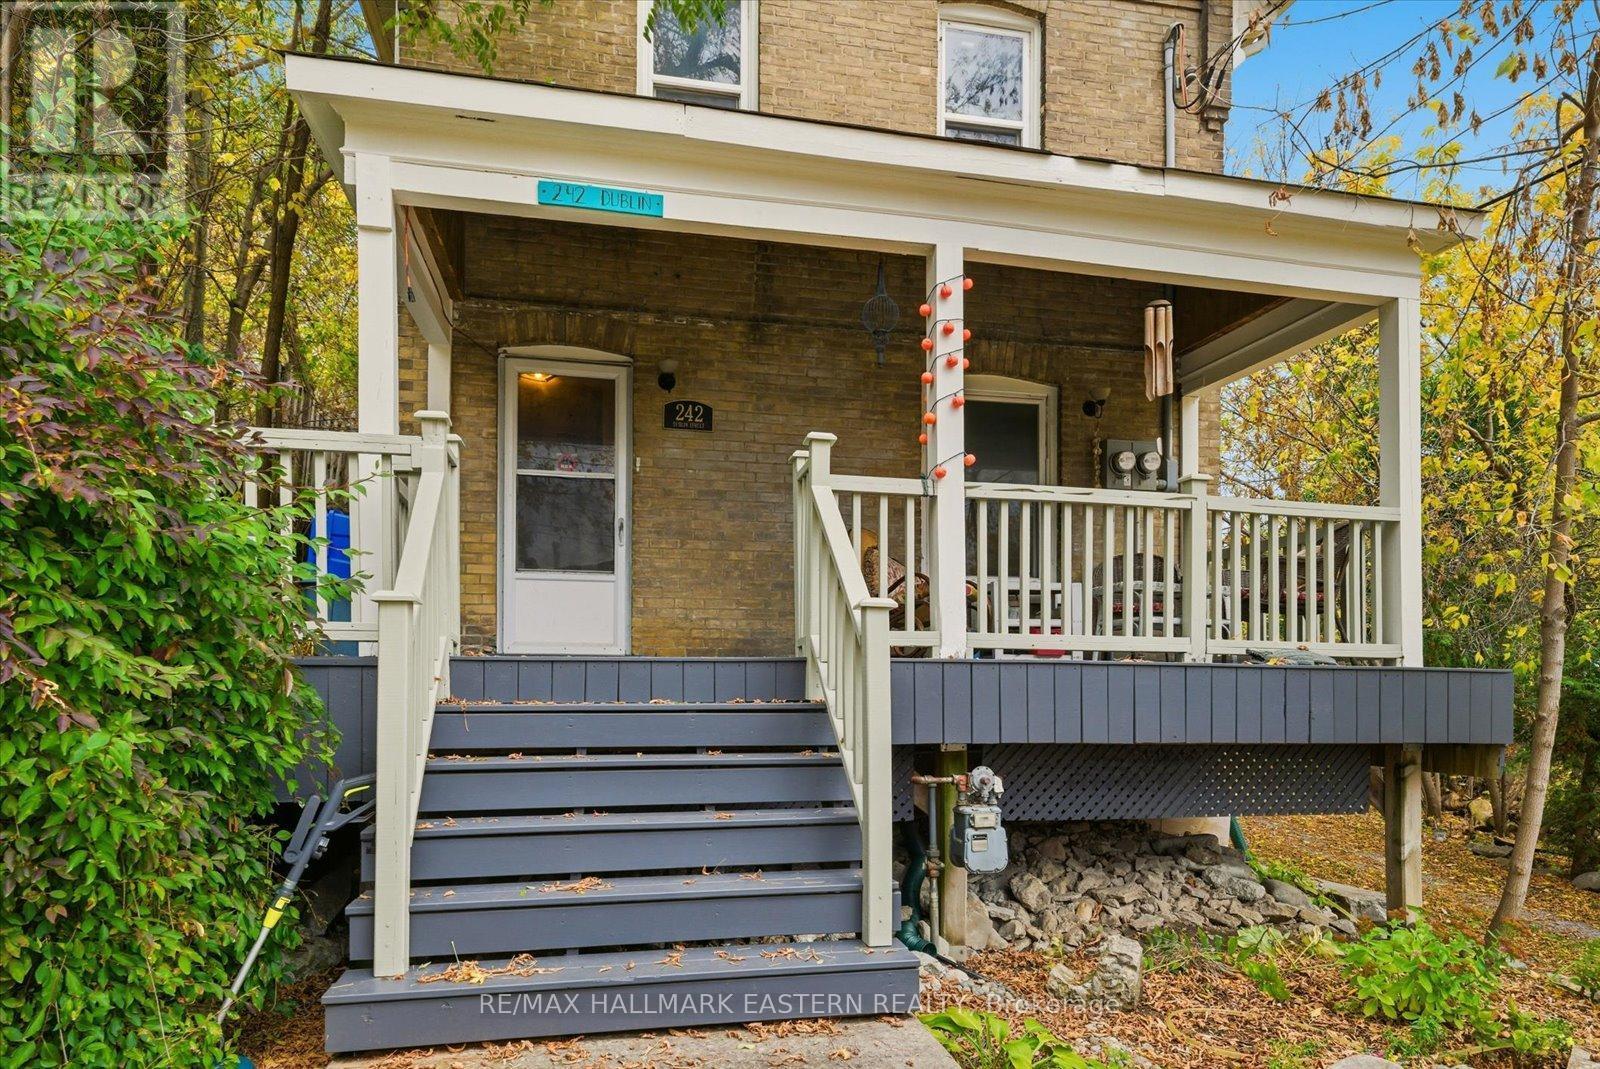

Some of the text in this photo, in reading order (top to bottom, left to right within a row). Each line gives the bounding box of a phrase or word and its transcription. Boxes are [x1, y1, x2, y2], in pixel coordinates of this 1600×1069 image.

[552, 184, 652, 211] 242 DUBLIN
[675, 403, 704, 423] 242
